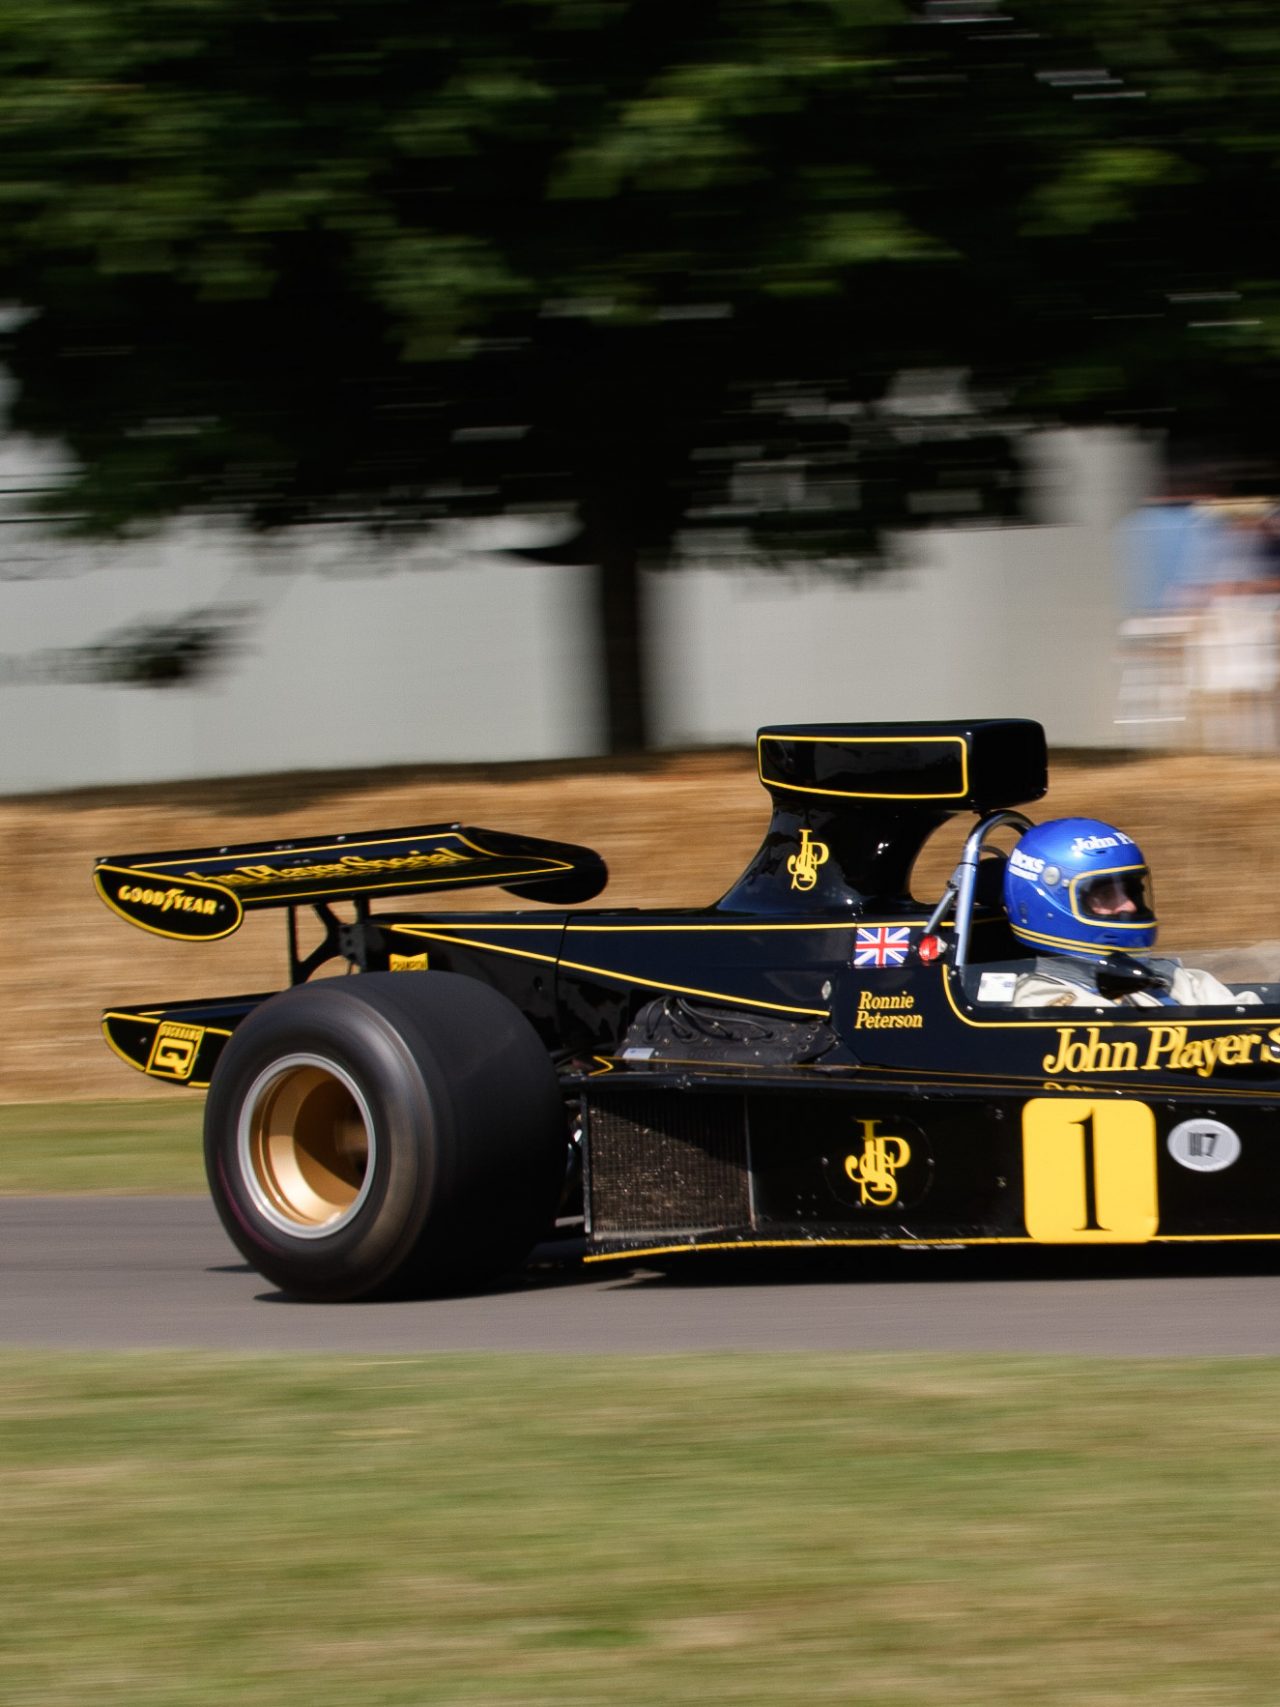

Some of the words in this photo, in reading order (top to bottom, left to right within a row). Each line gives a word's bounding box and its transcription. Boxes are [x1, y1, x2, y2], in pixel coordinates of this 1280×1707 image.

[1071, 835, 1120, 853] John
[118, 884, 218, 916] GOODYEAR
[857, 990, 915, 1010] Ronnie
[854, 1010, 924, 1030] Peterson
[1042, 1027, 1139, 1074] John
[1140, 1026, 1263, 1078] Player
[1067, 1105, 1113, 1232] 1
